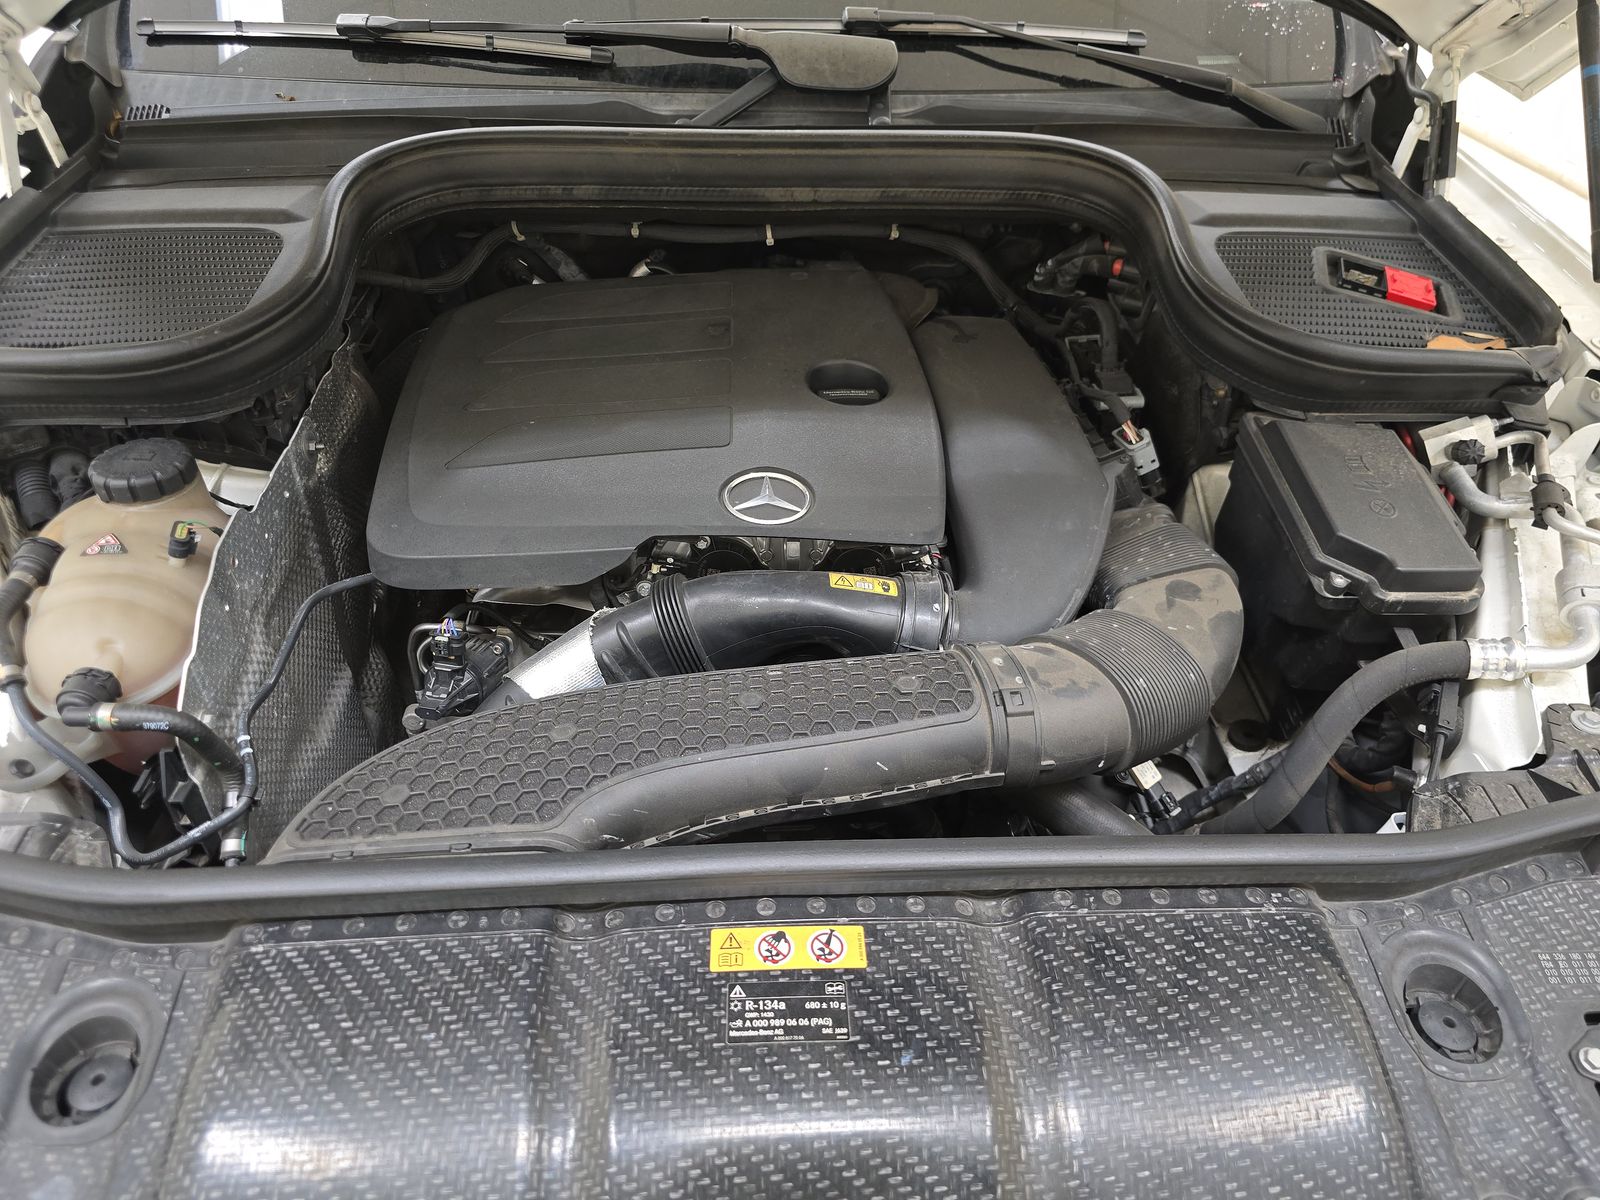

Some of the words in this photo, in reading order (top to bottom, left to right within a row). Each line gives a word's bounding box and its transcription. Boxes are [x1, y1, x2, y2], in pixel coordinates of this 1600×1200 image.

[1545, 968, 1558, 976] 010
[1560, 968, 1573, 976] 010
[1576, 968, 1589, 976] 010
[1591, 968, 1600, 976] 00
[1548, 976, 1561, 984] 001
[1564, 976, 1577, 984] 101
[1579, 976, 1592, 984] 011
[745, 1000, 786, 1010] R-134a
[840, 1002, 846, 1010] g
[744, 1020, 752, 1028] A
[752, 1019, 769, 1027] 000
[769, 1019, 785, 1027] 989
[786, 1018, 798, 1026] 06
[798, 1018, 810, 1026] 06
[811, 1017, 833, 1027] (PAG)
